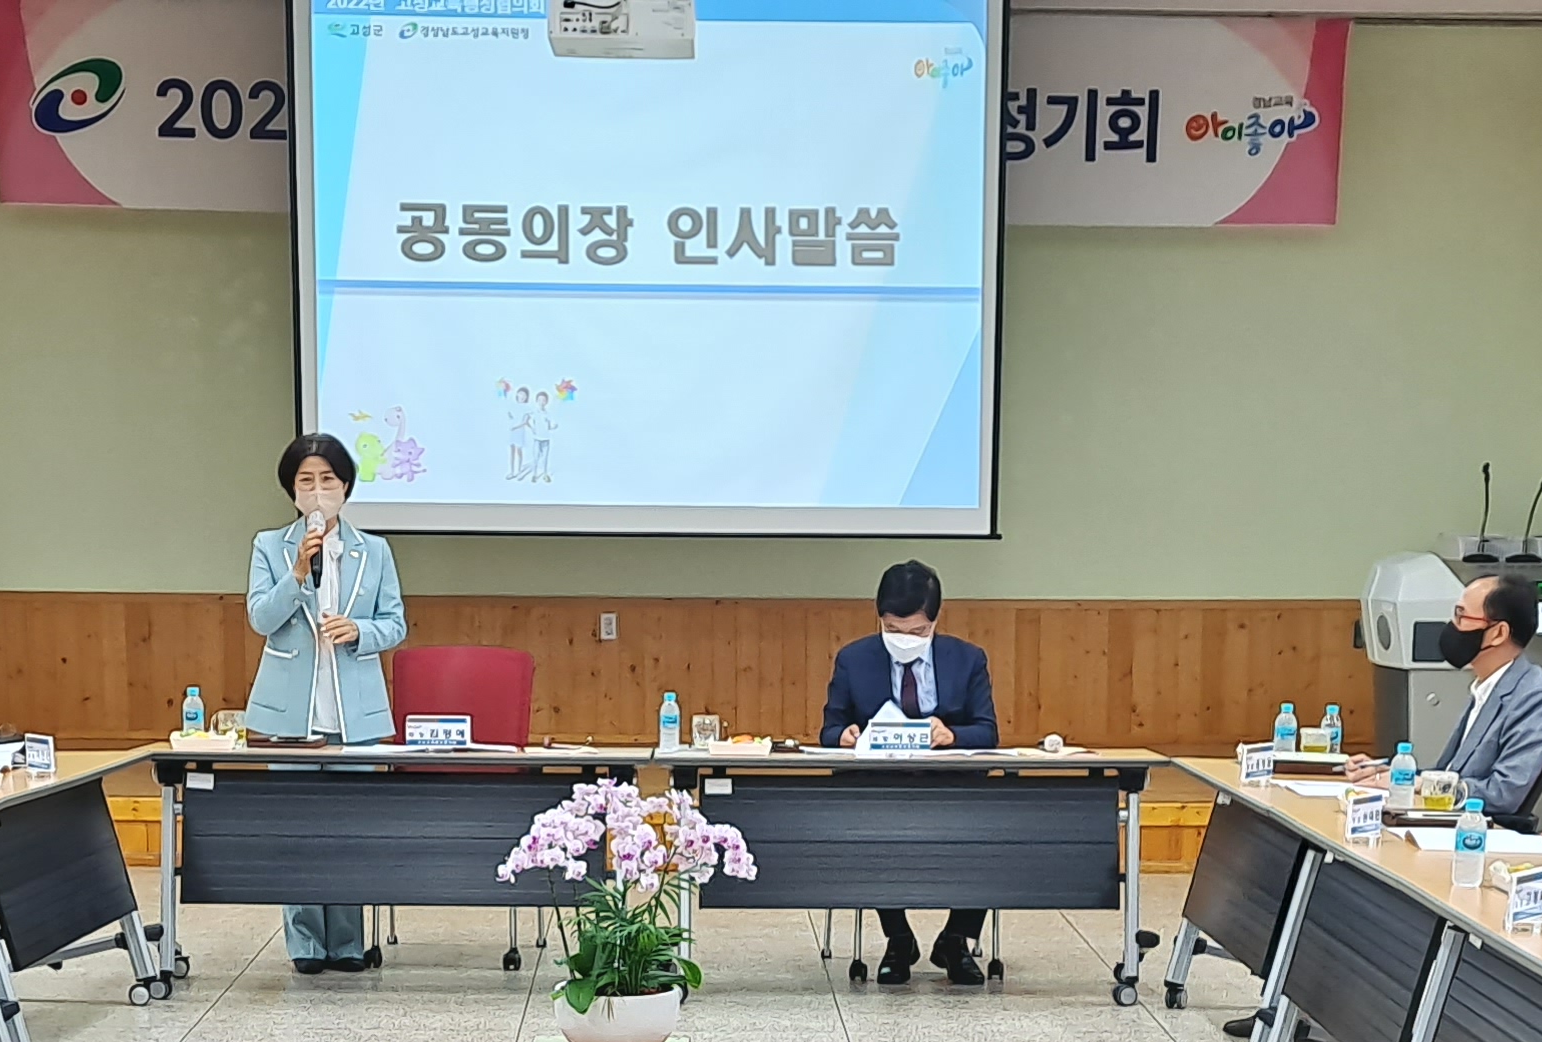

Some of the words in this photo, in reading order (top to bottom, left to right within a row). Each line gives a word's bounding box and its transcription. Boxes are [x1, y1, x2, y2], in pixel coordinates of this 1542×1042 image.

[349, 24, 383, 37] 고성군
[396, 202, 634, 265] 공동의장
[667, 205, 900, 267] 인사말씀
